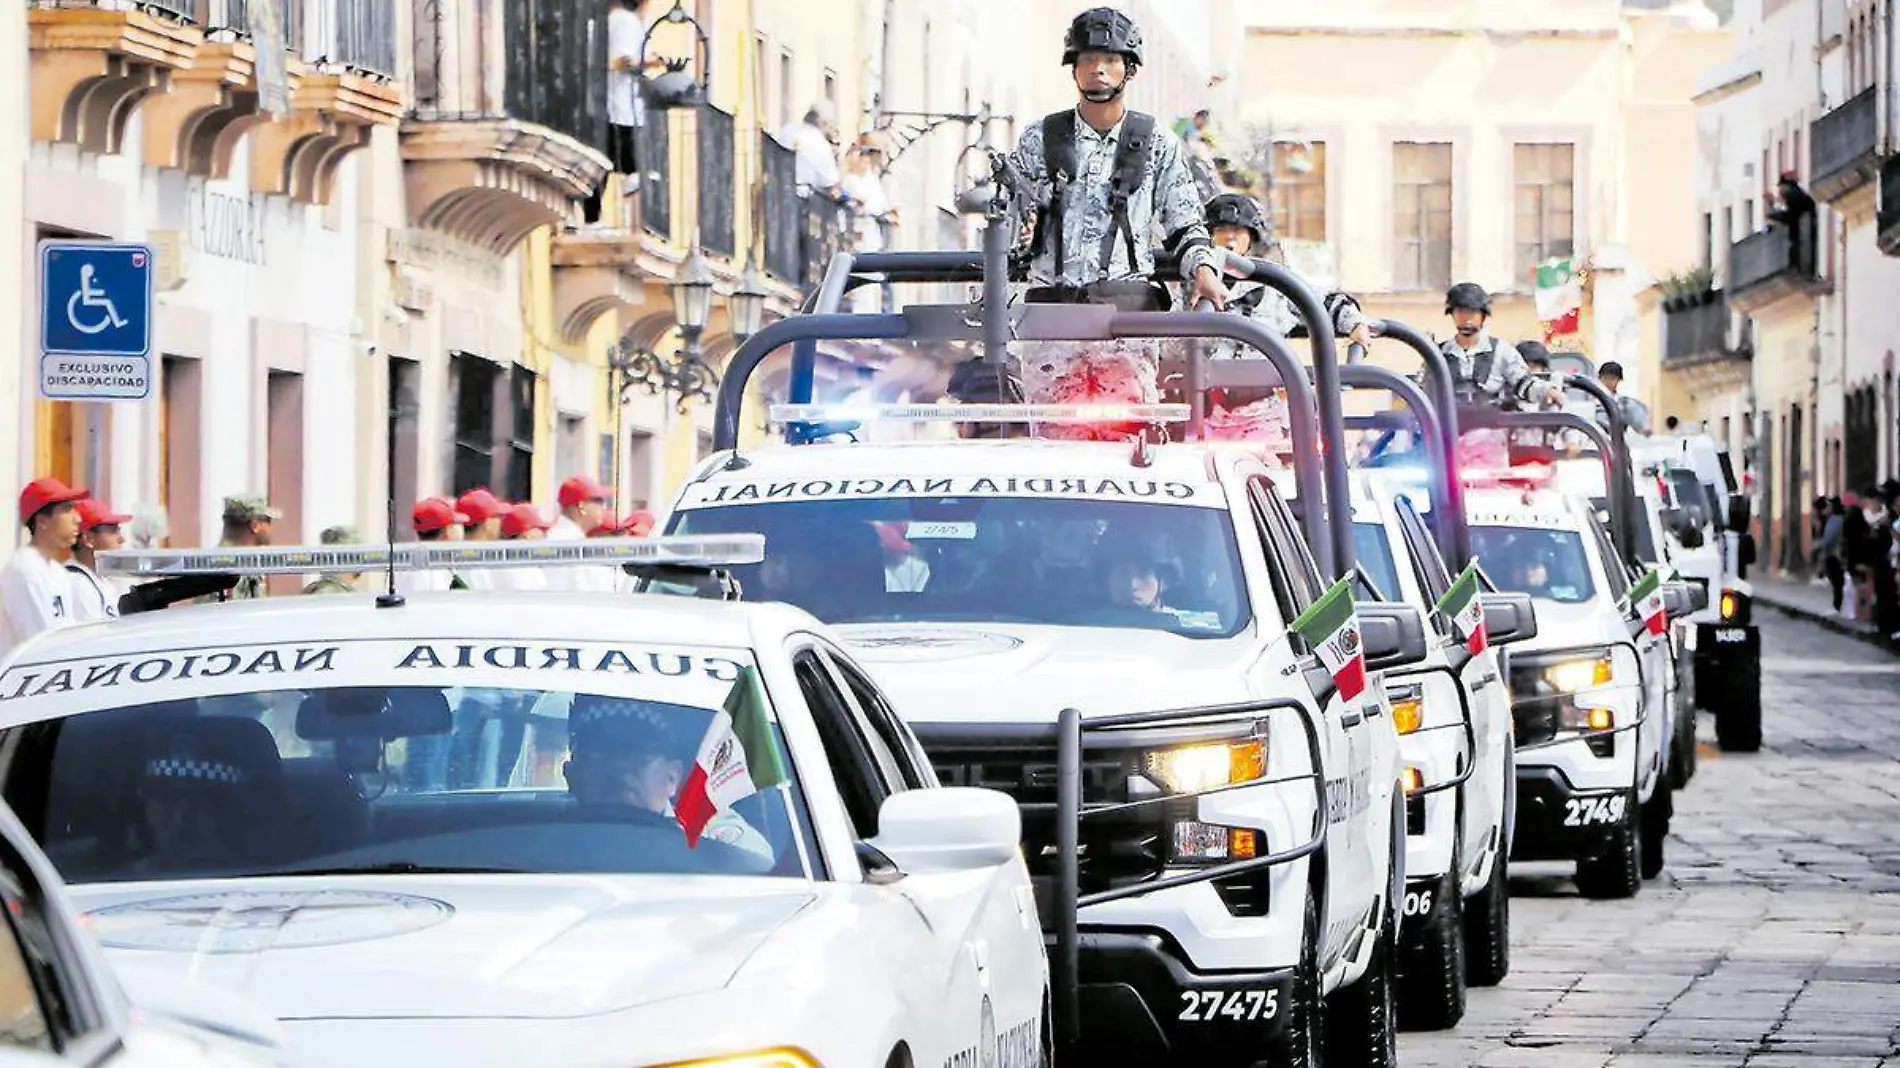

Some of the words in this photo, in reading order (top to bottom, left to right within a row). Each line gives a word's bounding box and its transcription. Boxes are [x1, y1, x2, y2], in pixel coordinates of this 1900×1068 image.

[59, 363, 133, 374] EXCLUSIVO
[47, 376, 144, 387] DISCAPACIDAD
[1404, 890, 1431, 916] 06
[1179, 988, 1278, 1021] 27475
